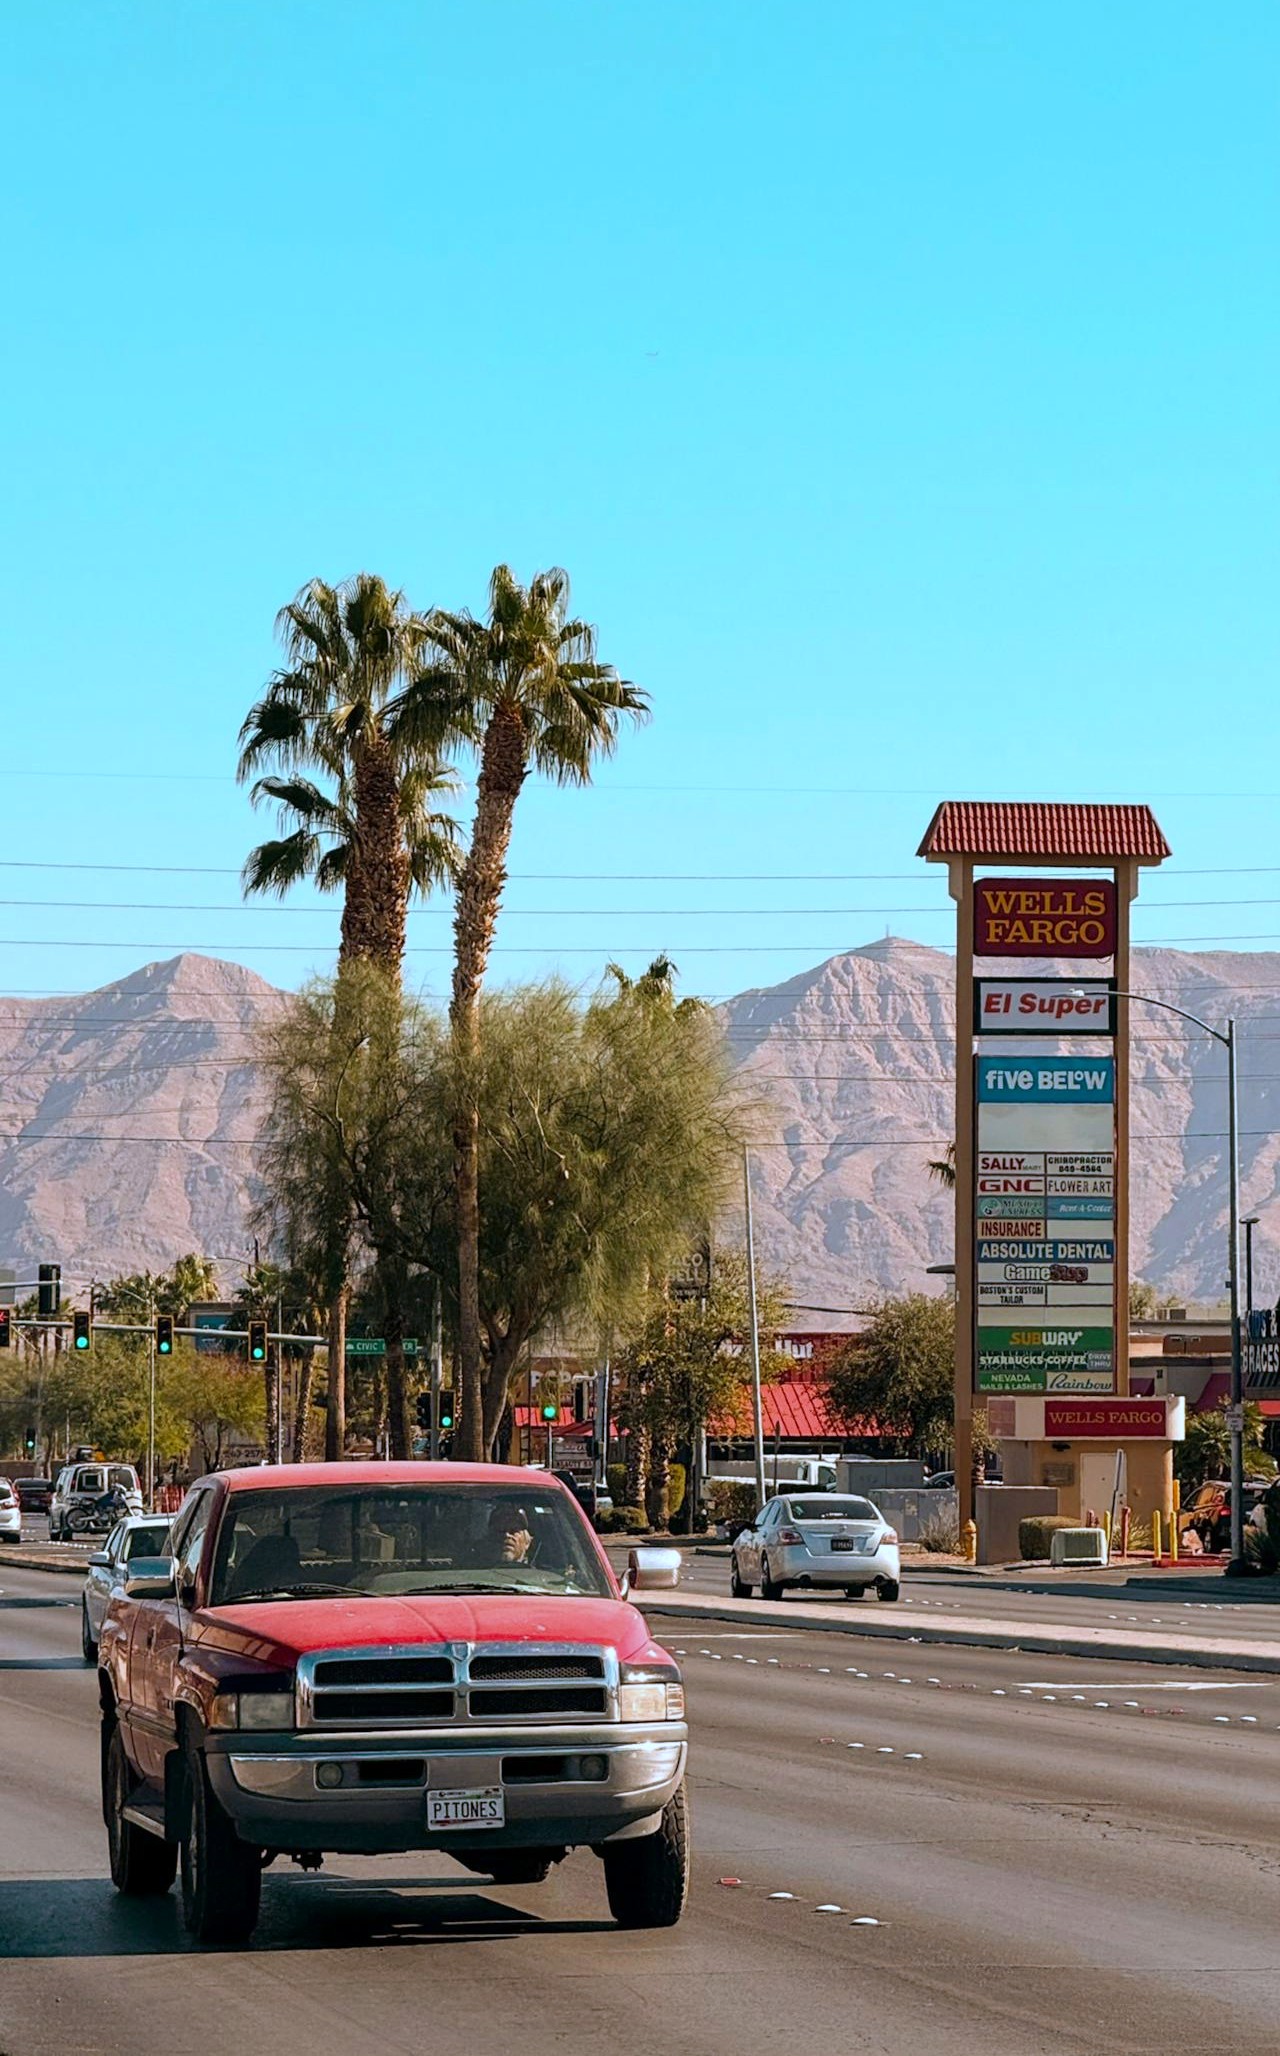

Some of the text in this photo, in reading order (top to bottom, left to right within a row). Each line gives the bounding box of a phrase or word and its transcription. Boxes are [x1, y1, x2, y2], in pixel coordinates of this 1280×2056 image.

[983, 890, 1106, 916] WELLS
[985, 919, 1106, 944] FARGO
[984, 993, 1107, 1019] El Super
[985, 1069, 1034, 1090] five
[981, 1157, 1025, 1170] SALLY
[1048, 1156, 1112, 1165] CHIROPRACTOR
[980, 1179, 1044, 1192] GNC
[1048, 1180, 1112, 1193] FLOWER ART
[981, 1222, 1042, 1237] INSURANCE
[980, 1243, 1112, 1259] ABSOLUTE DENTAL
[1014, 1285, 1044, 1295] CUSTOM
[1000, 1295, 1024, 1304] TAILOR
[1009, 1331, 1083, 1346] SUBWAY
[356, 1342, 379, 1351] CIVIC
[980, 1355, 1087, 1365] STARBUCKS COFFEE
[1241, 1343, 1280, 1373] BRACES
[991, 1374, 1031, 1382] NEVADA
[1050, 1373, 1112, 1390] Rainbow
[1050, 1412, 1163, 1424] WELLS FARGO
[433, 1800, 497, 1819] PITONES
